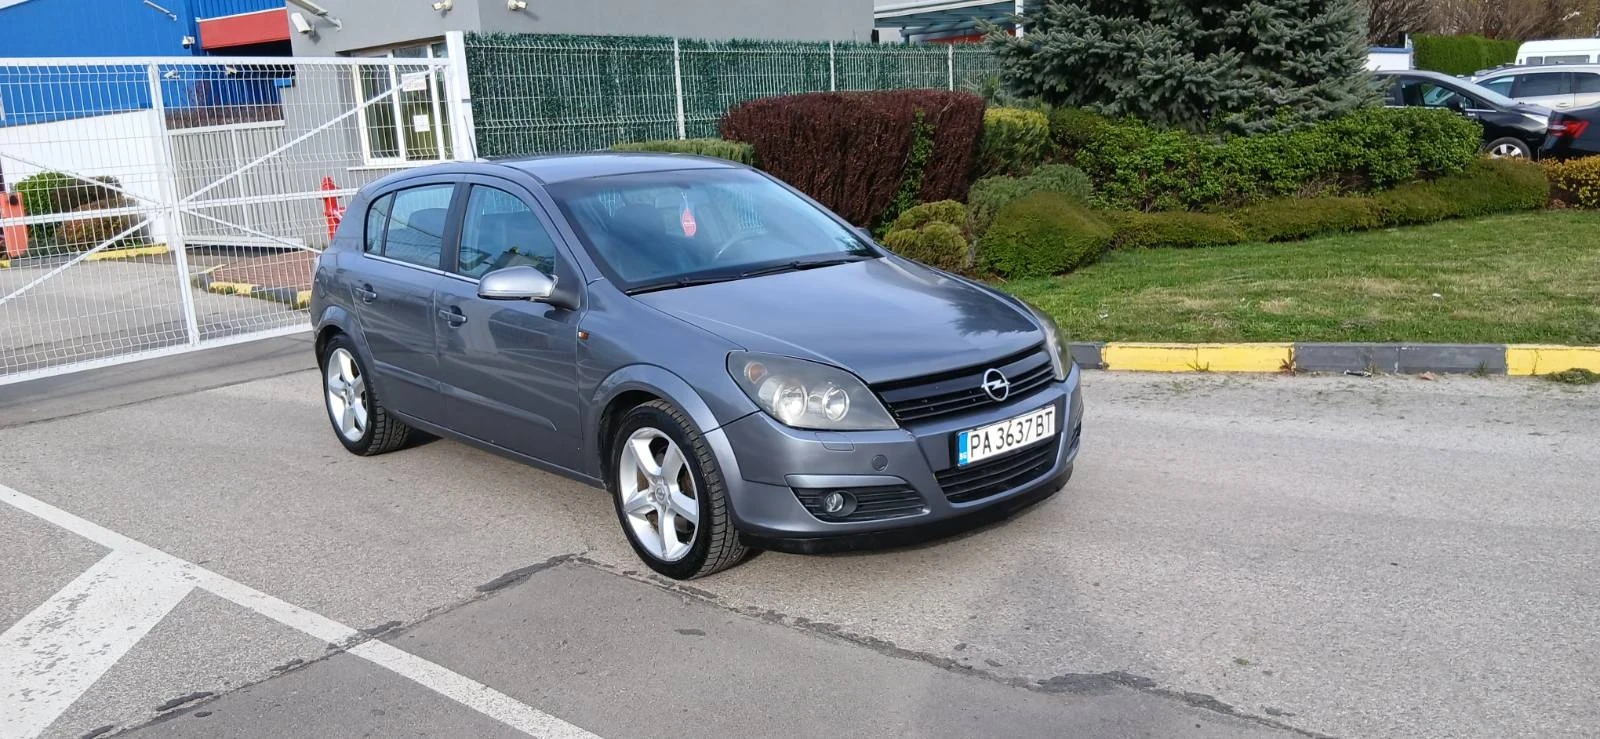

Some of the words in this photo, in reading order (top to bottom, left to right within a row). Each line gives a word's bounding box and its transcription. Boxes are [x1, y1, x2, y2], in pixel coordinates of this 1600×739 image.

[970, 431, 992, 458] PA
[996, 418, 1033, 450] 3637
[1036, 411, 1053, 437] BT
